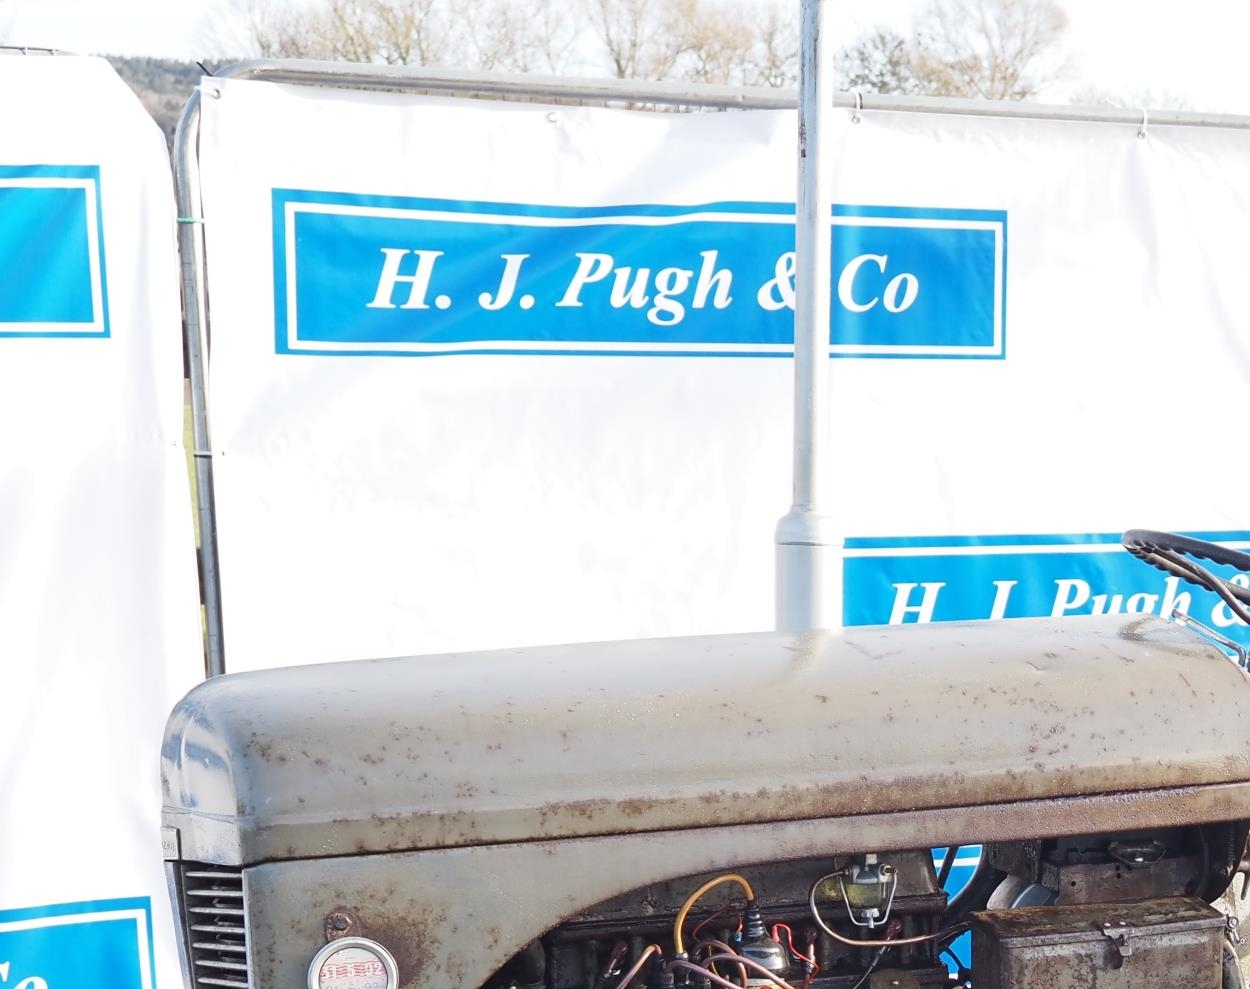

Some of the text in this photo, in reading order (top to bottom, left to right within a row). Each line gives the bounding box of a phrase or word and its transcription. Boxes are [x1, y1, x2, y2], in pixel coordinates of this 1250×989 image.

[366, 247, 919, 326] H. J. Pugh & Co
